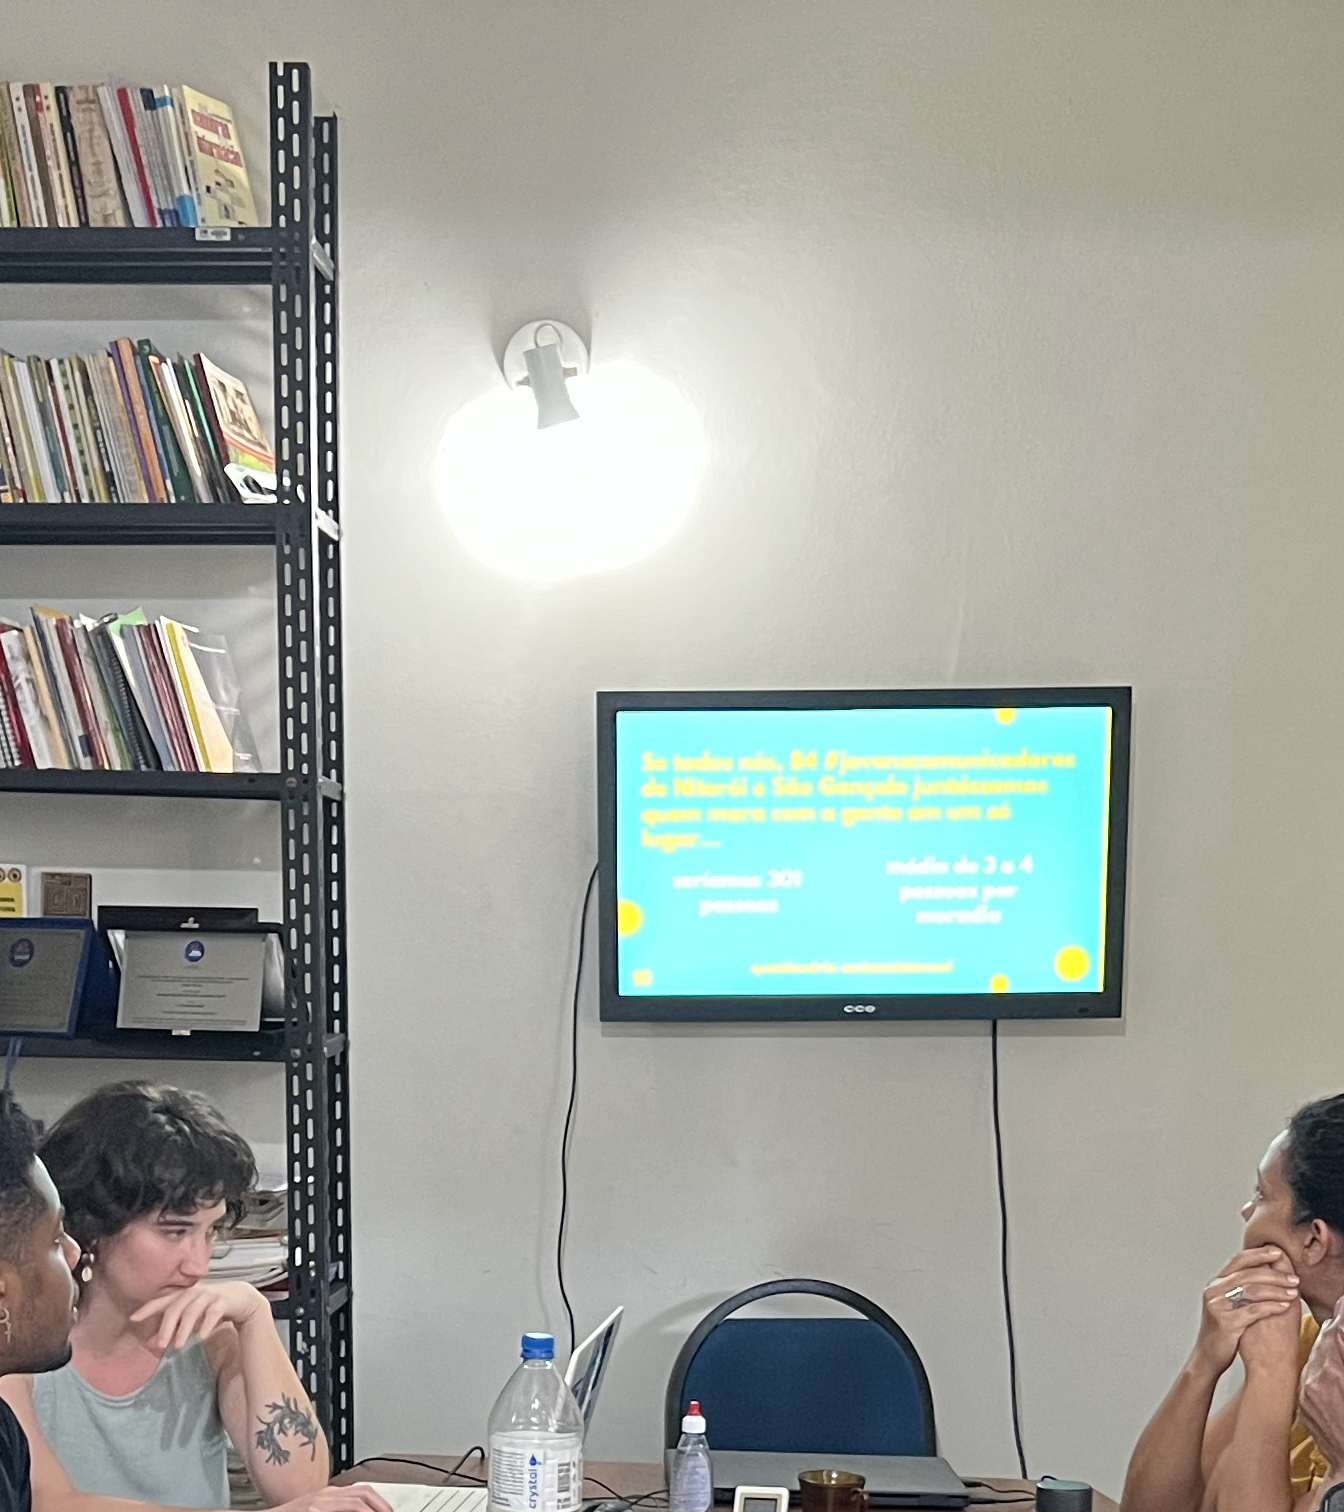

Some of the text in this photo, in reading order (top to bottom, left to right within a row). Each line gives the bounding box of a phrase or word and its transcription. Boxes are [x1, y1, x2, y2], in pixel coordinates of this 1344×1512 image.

[641, 776, 667, 797] de
[674, 776, 748, 797] Niterói
[773, 776, 814, 796] São
[819, 774, 909, 801] Gonçalo
[982, 854, 997, 875] 3
[1018, 852, 1033, 873] 4
[528, 1468, 540, 1509] crystal
